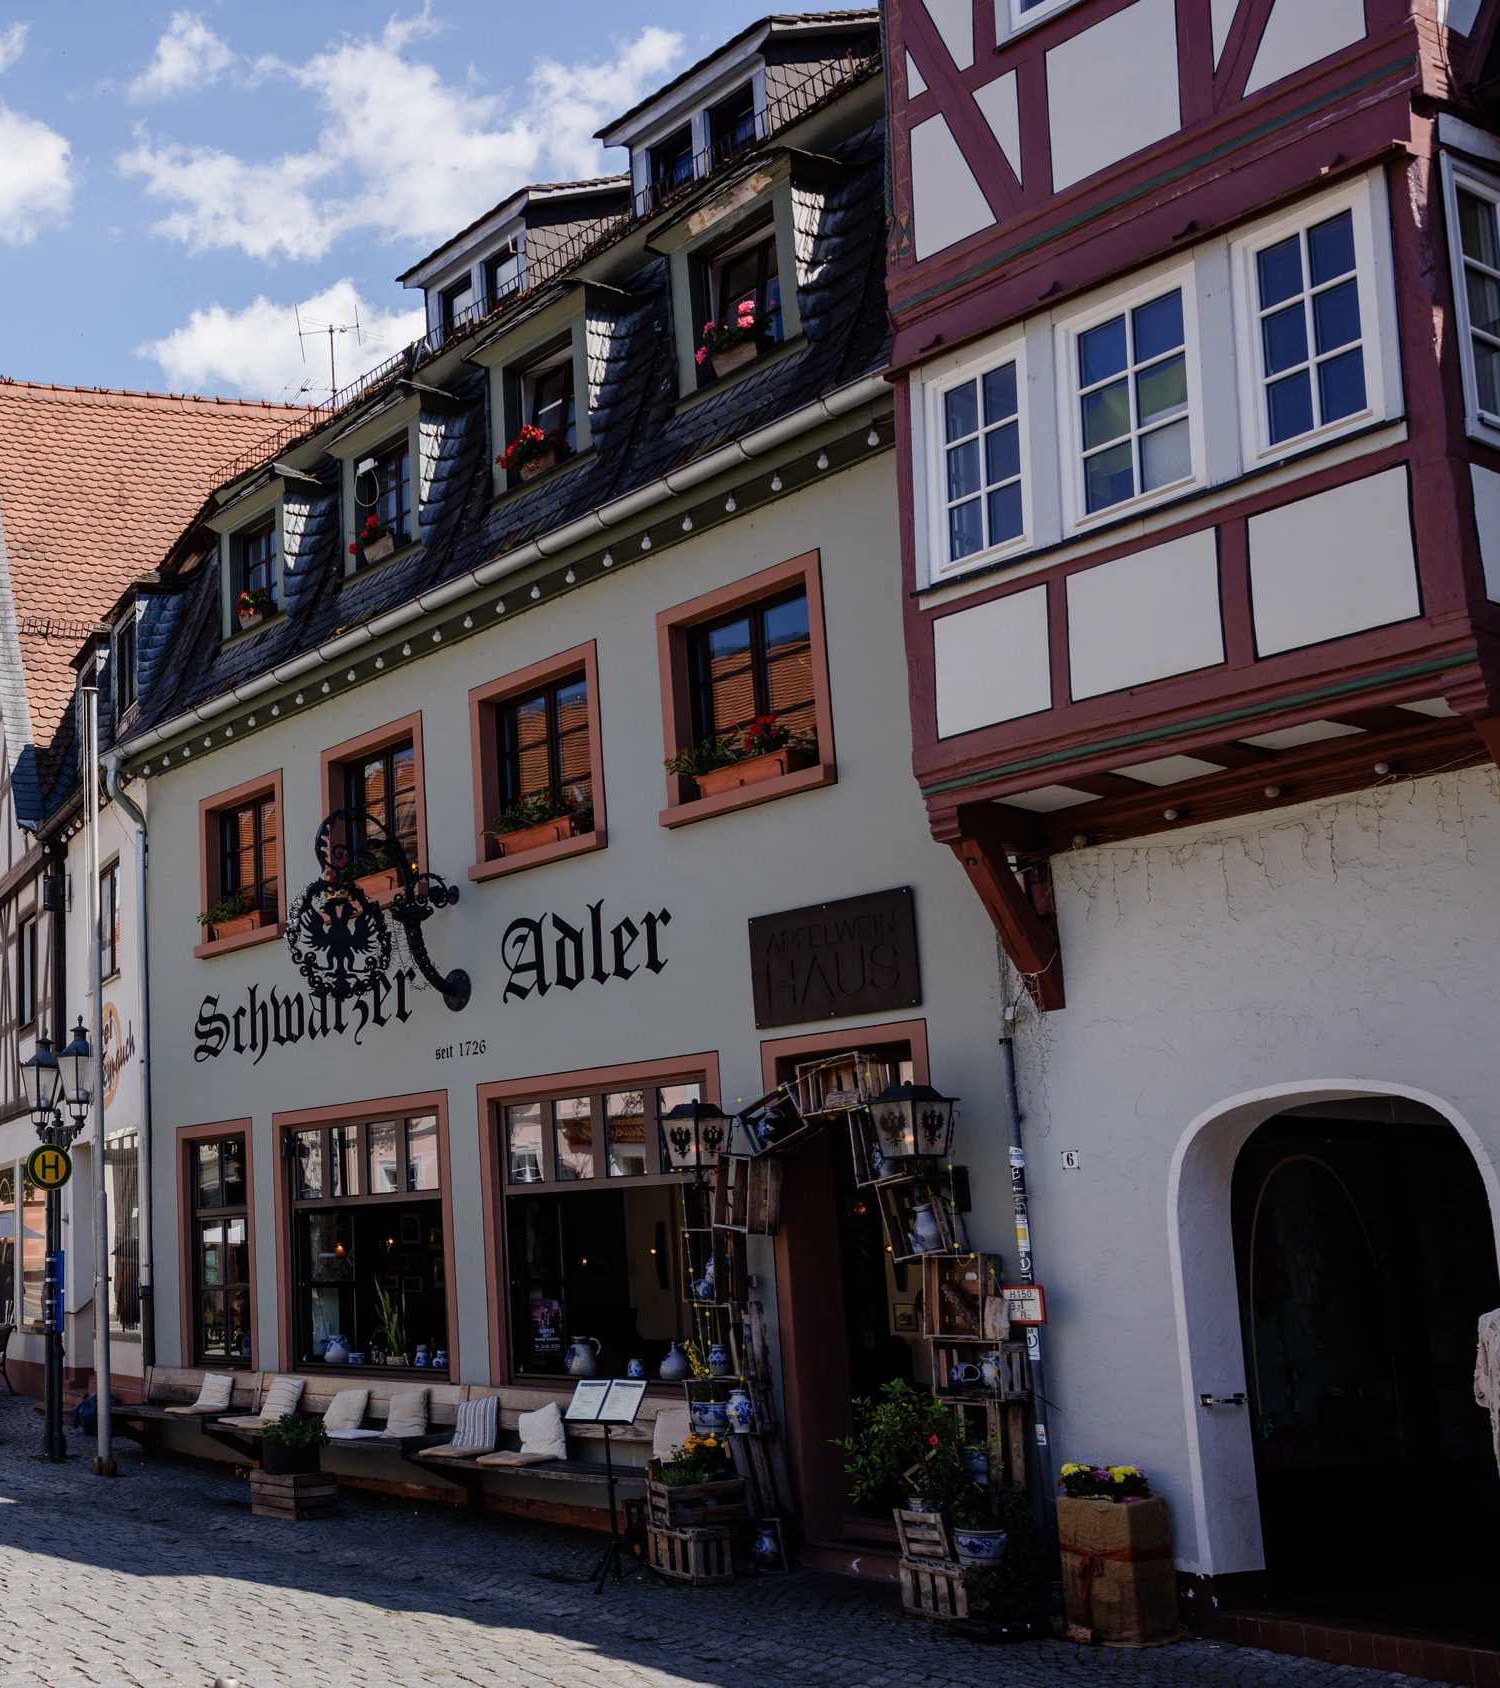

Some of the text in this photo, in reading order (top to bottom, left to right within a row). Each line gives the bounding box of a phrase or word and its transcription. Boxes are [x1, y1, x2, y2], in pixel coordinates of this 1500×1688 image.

[766, 910, 896, 956] APFELWEIN
[501, 898, 672, 1004] Adler
[766, 942, 900, 1007] HAUS
[435, 1039, 487, 1060] seit 1726
[41, 1154, 60, 1180] H
[1066, 1152, 1074, 1167] 6
[1009, 1289, 1032, 1299] H150
